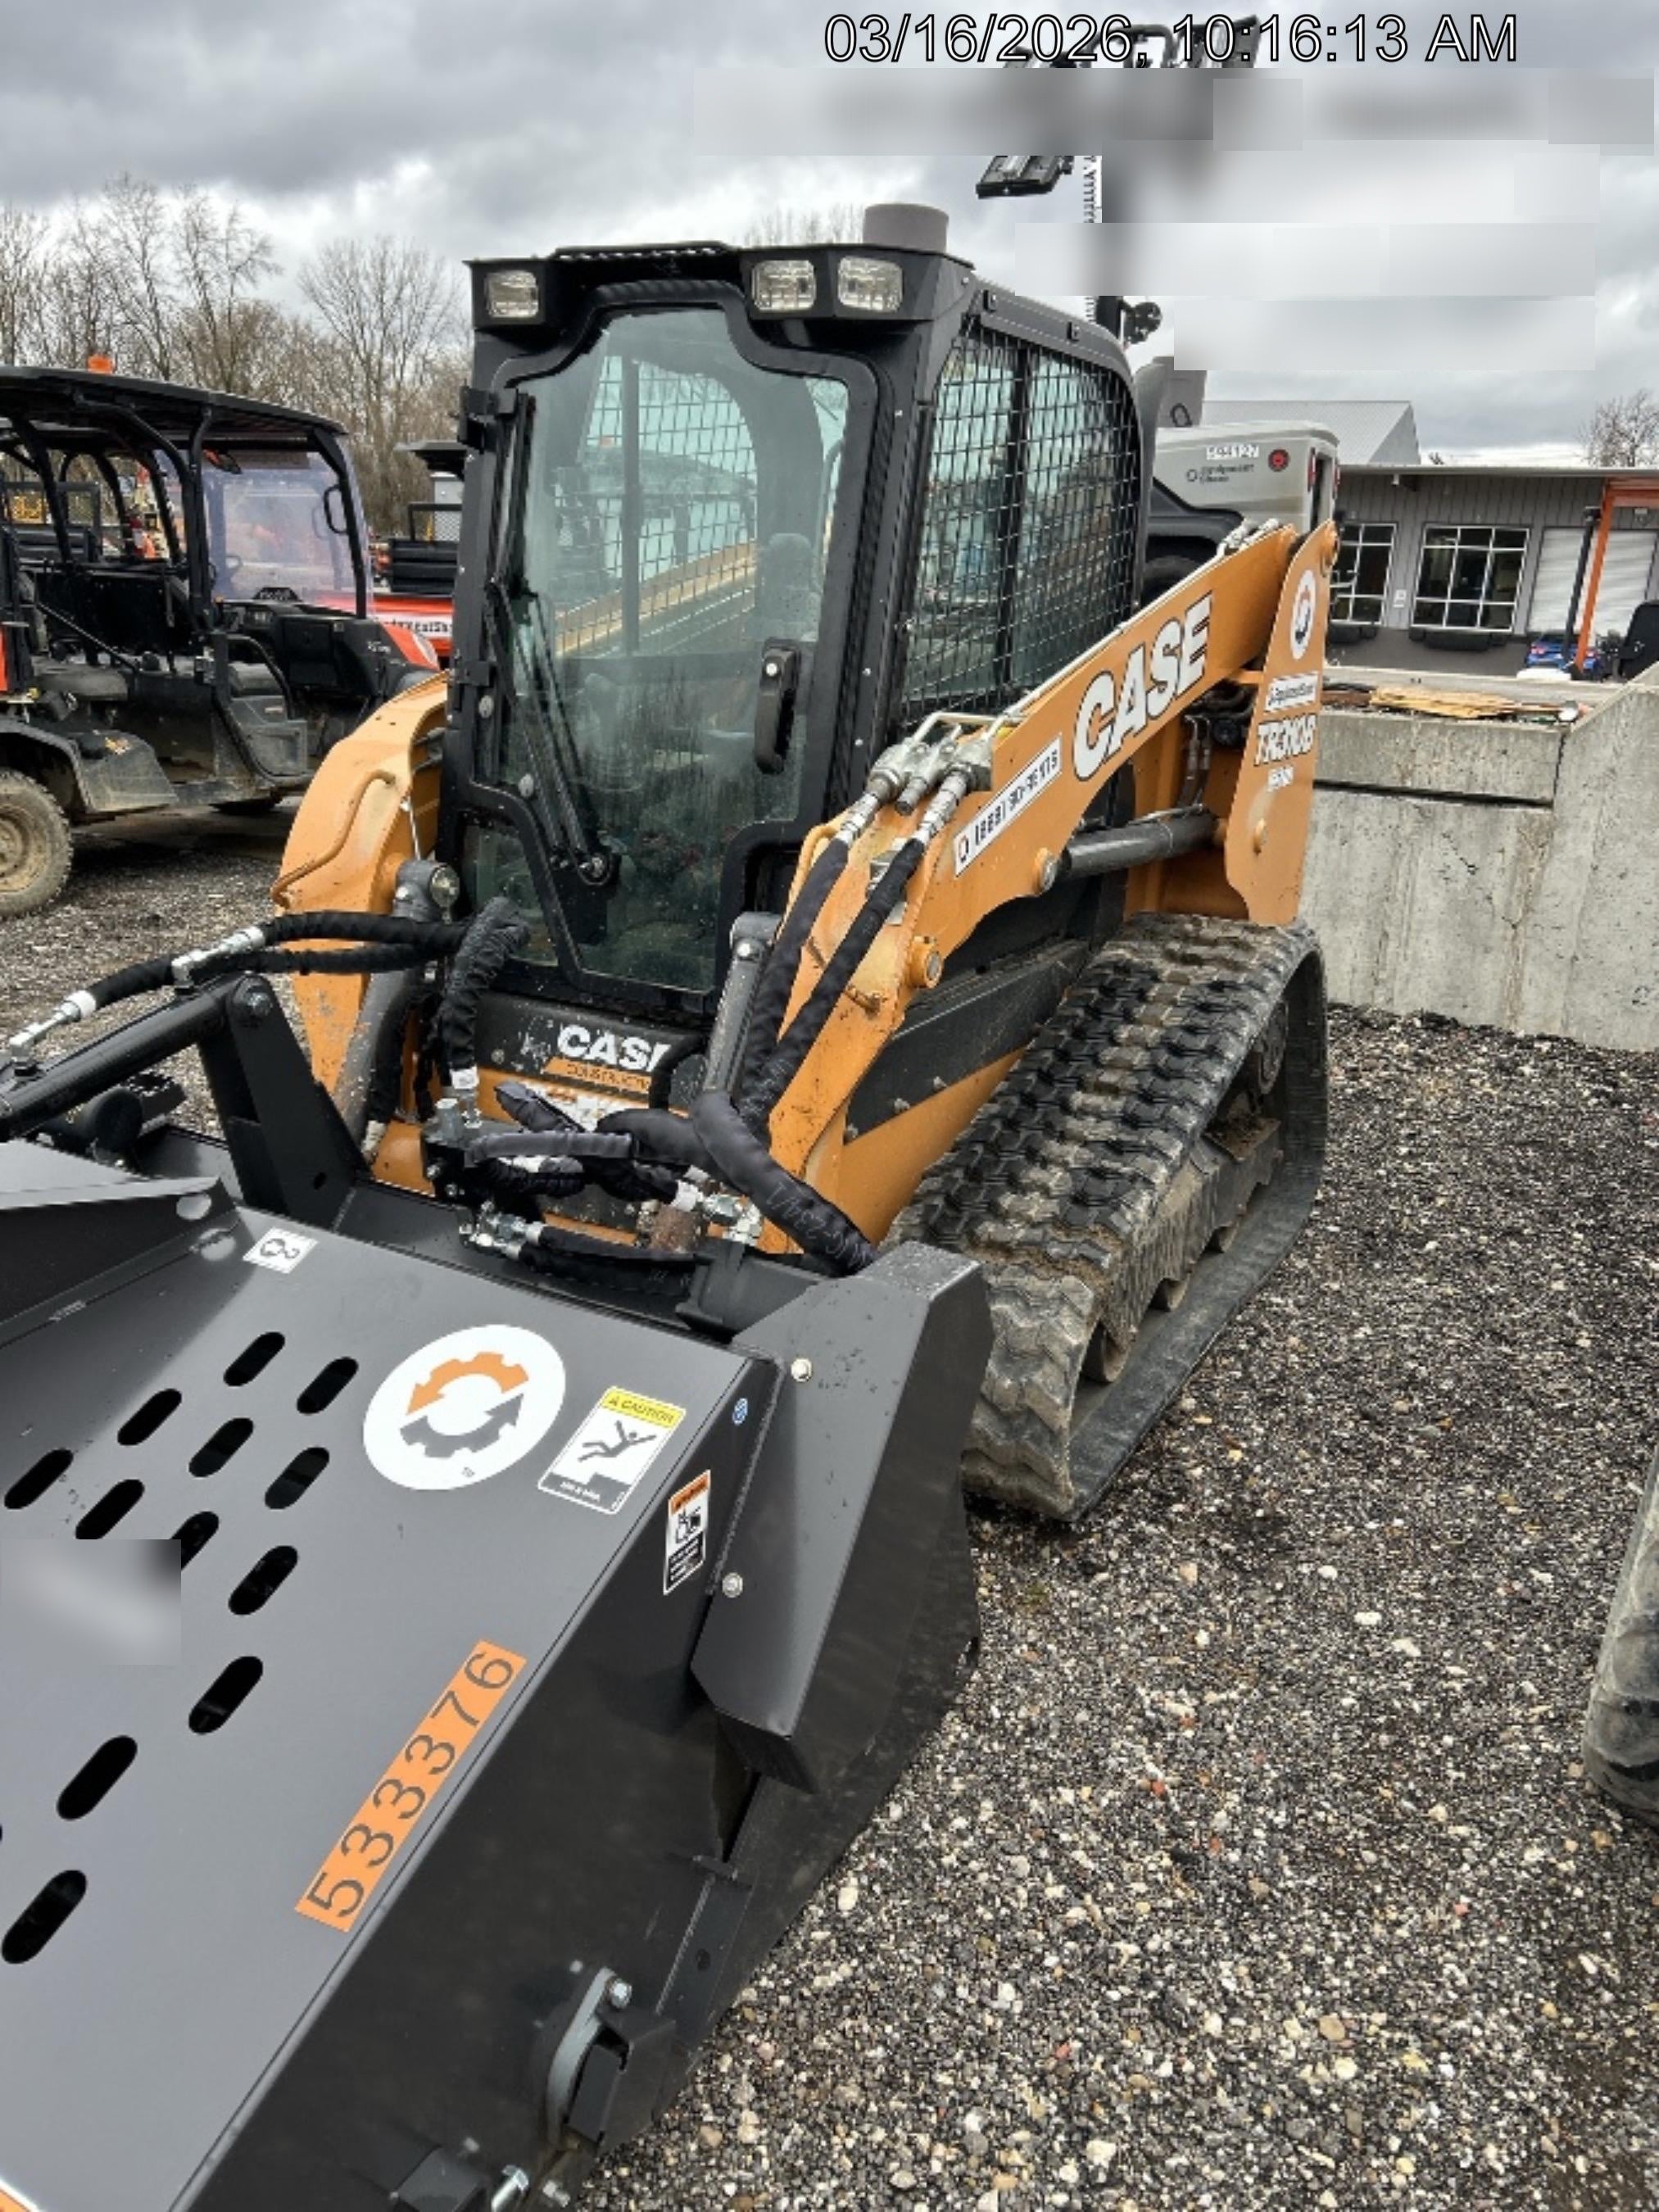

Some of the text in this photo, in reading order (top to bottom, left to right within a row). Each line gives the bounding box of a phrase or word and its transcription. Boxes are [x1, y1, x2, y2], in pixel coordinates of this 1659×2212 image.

[1072, 590, 1213, 782] CASE
[621, 1399, 674, 1424] CAUTION
[306, 1651, 514, 1918] 533376
